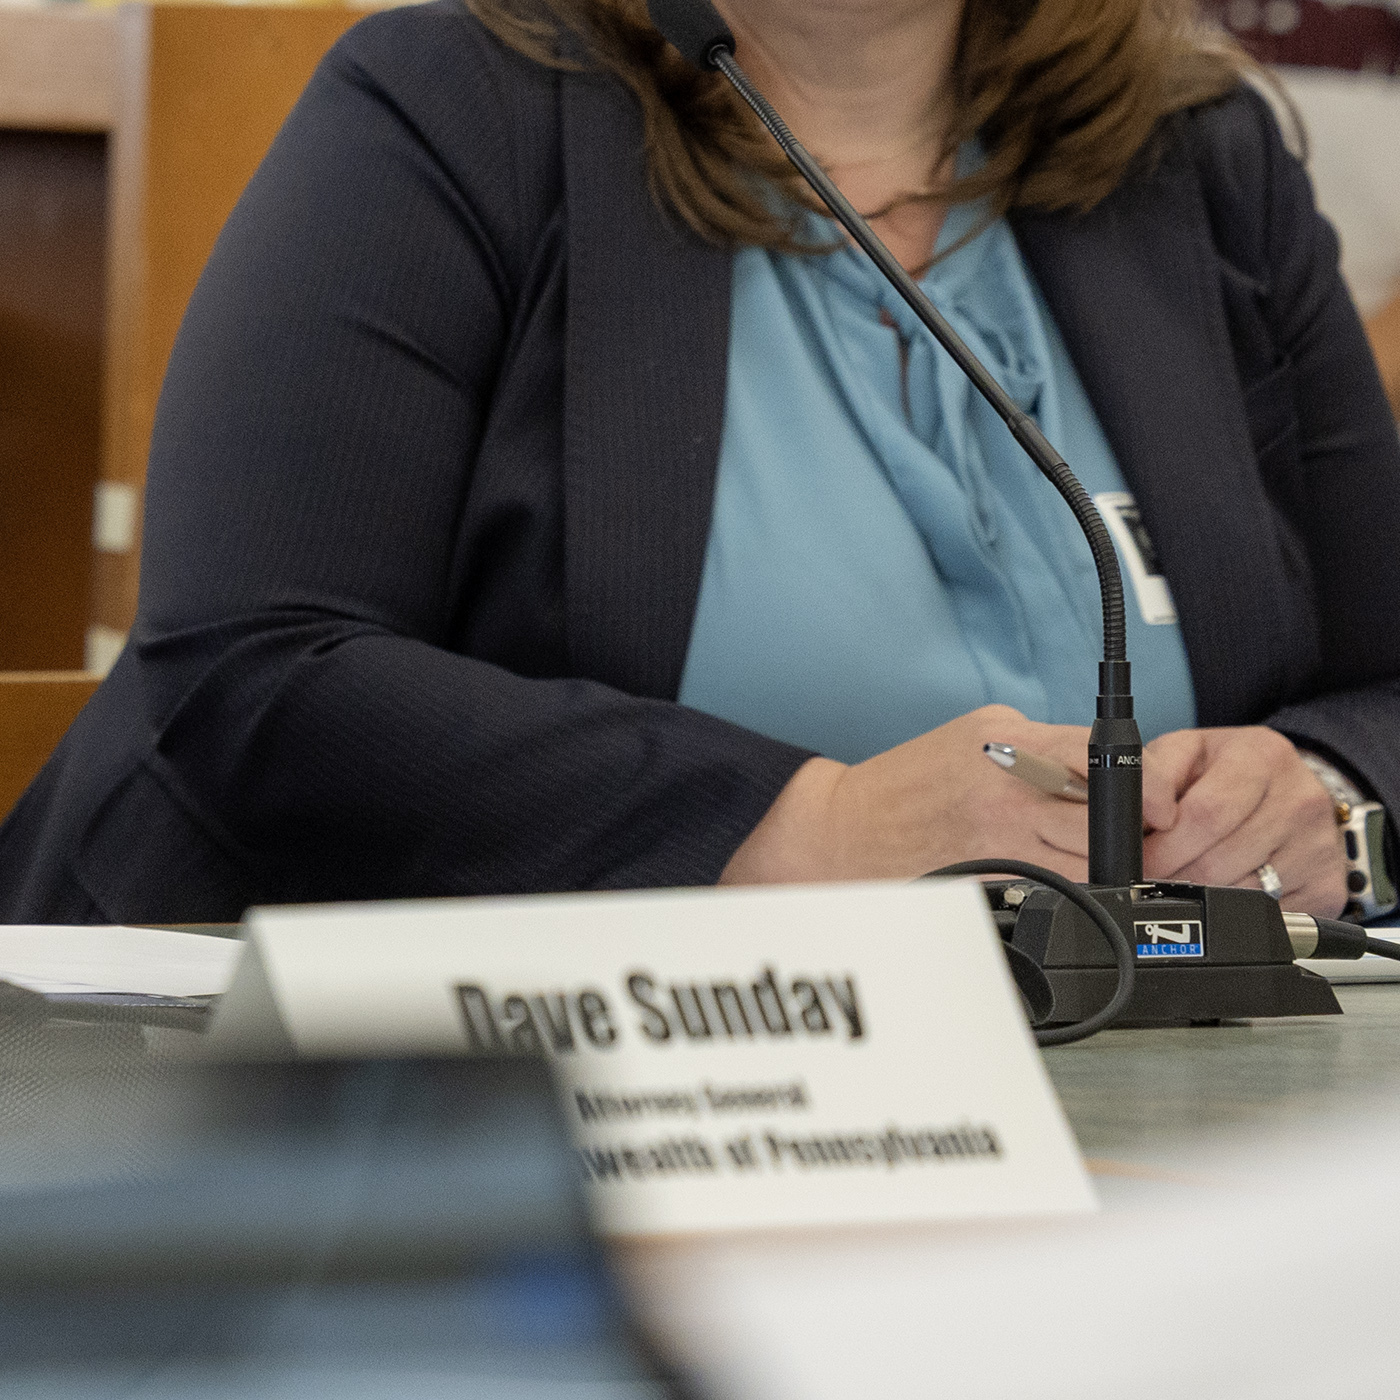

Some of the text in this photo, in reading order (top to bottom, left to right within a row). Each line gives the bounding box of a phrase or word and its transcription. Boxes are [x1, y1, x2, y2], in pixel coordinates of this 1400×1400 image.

[1142, 944, 1196, 955] ANCHOR
[454, 963, 867, 1052] Dave Sunday
[581, 1136, 714, 1183] wealth
[763, 1119, 1004, 1171] Pennsylvania
